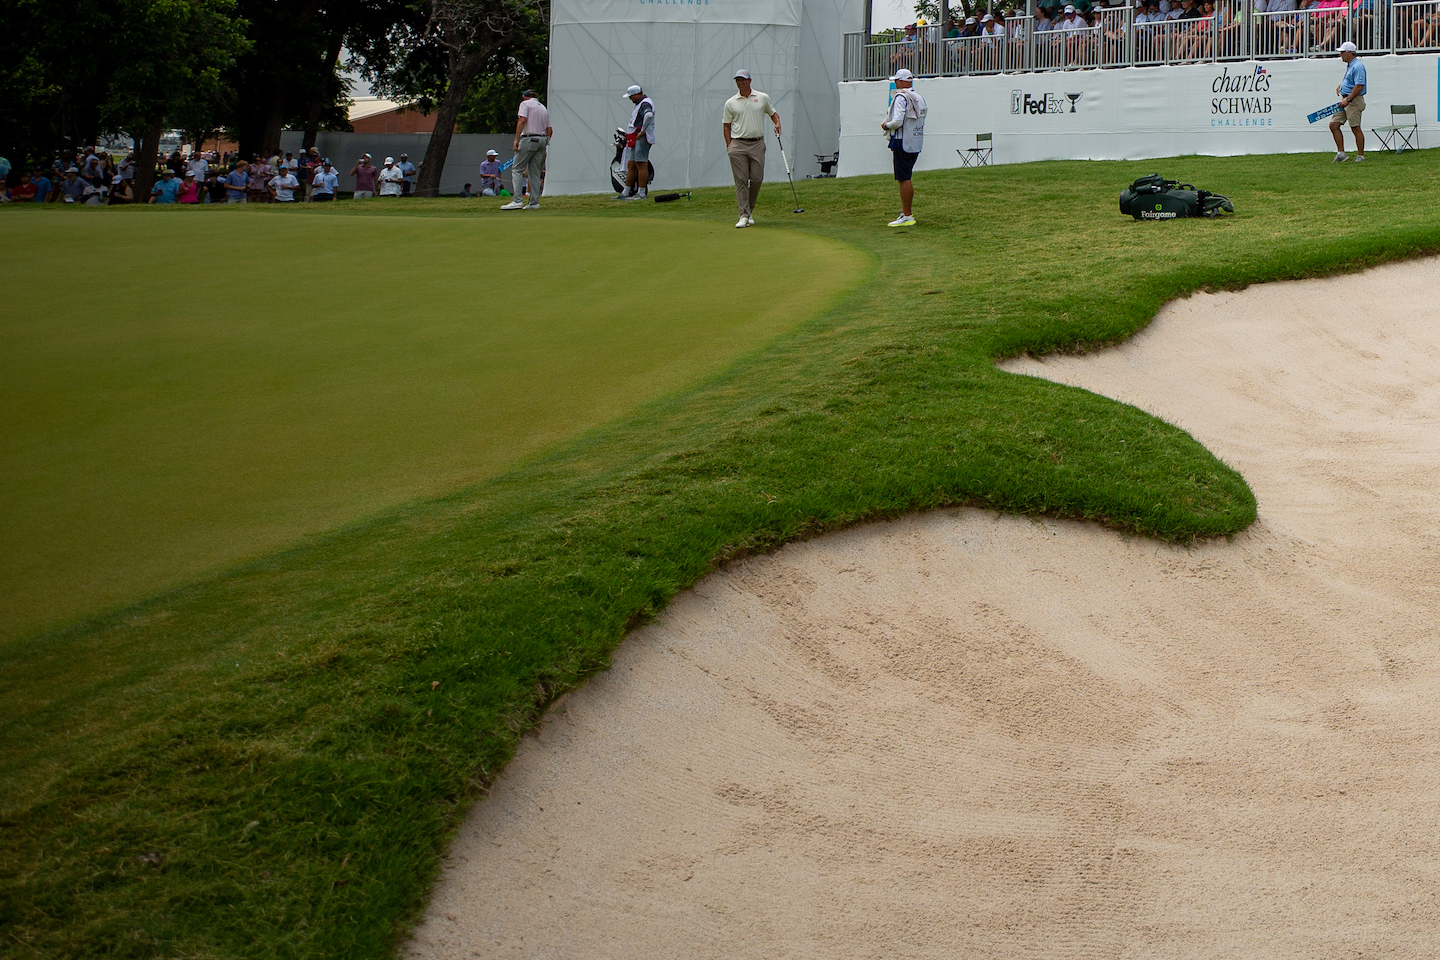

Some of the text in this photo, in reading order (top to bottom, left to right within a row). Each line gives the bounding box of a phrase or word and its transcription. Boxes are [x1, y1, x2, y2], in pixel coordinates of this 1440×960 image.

[1212, 64, 1272, 93] charles
[1023, 93, 1064, 114] FedEx
[1211, 97, 1272, 114] SCHWAB
[1141, 210, 1177, 220] Fairgame
